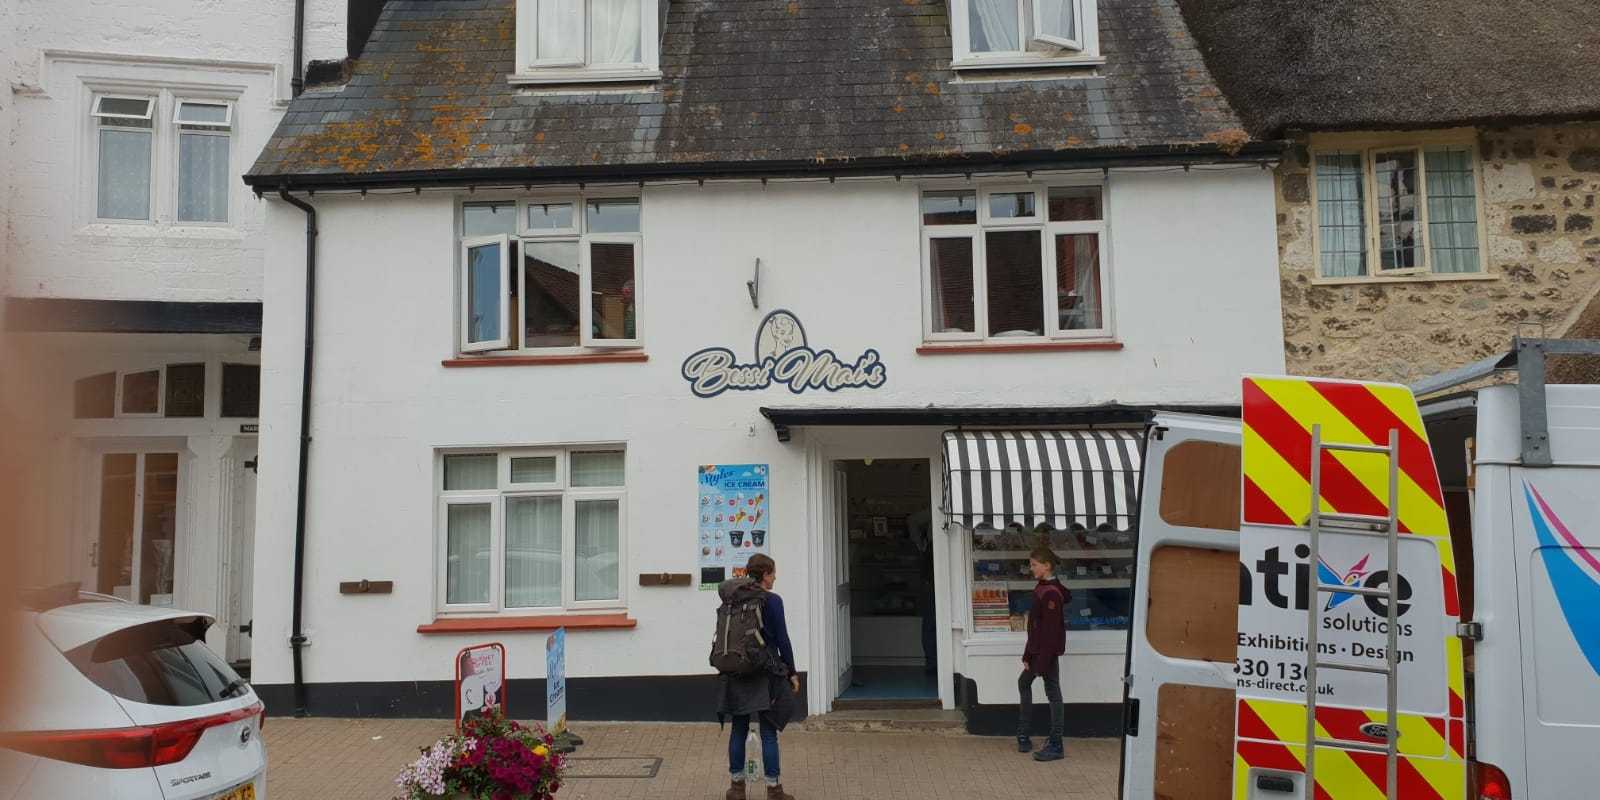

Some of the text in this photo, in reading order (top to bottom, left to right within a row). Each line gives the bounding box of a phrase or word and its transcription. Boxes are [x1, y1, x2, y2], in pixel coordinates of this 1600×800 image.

[724, 480, 765, 488] ICE CREAM
[1237, 632, 1337, 655] Exhibitins
[1276, 662, 1308, 681] 13
[1237, 677, 1334, 696] ns-direct.c.uk
